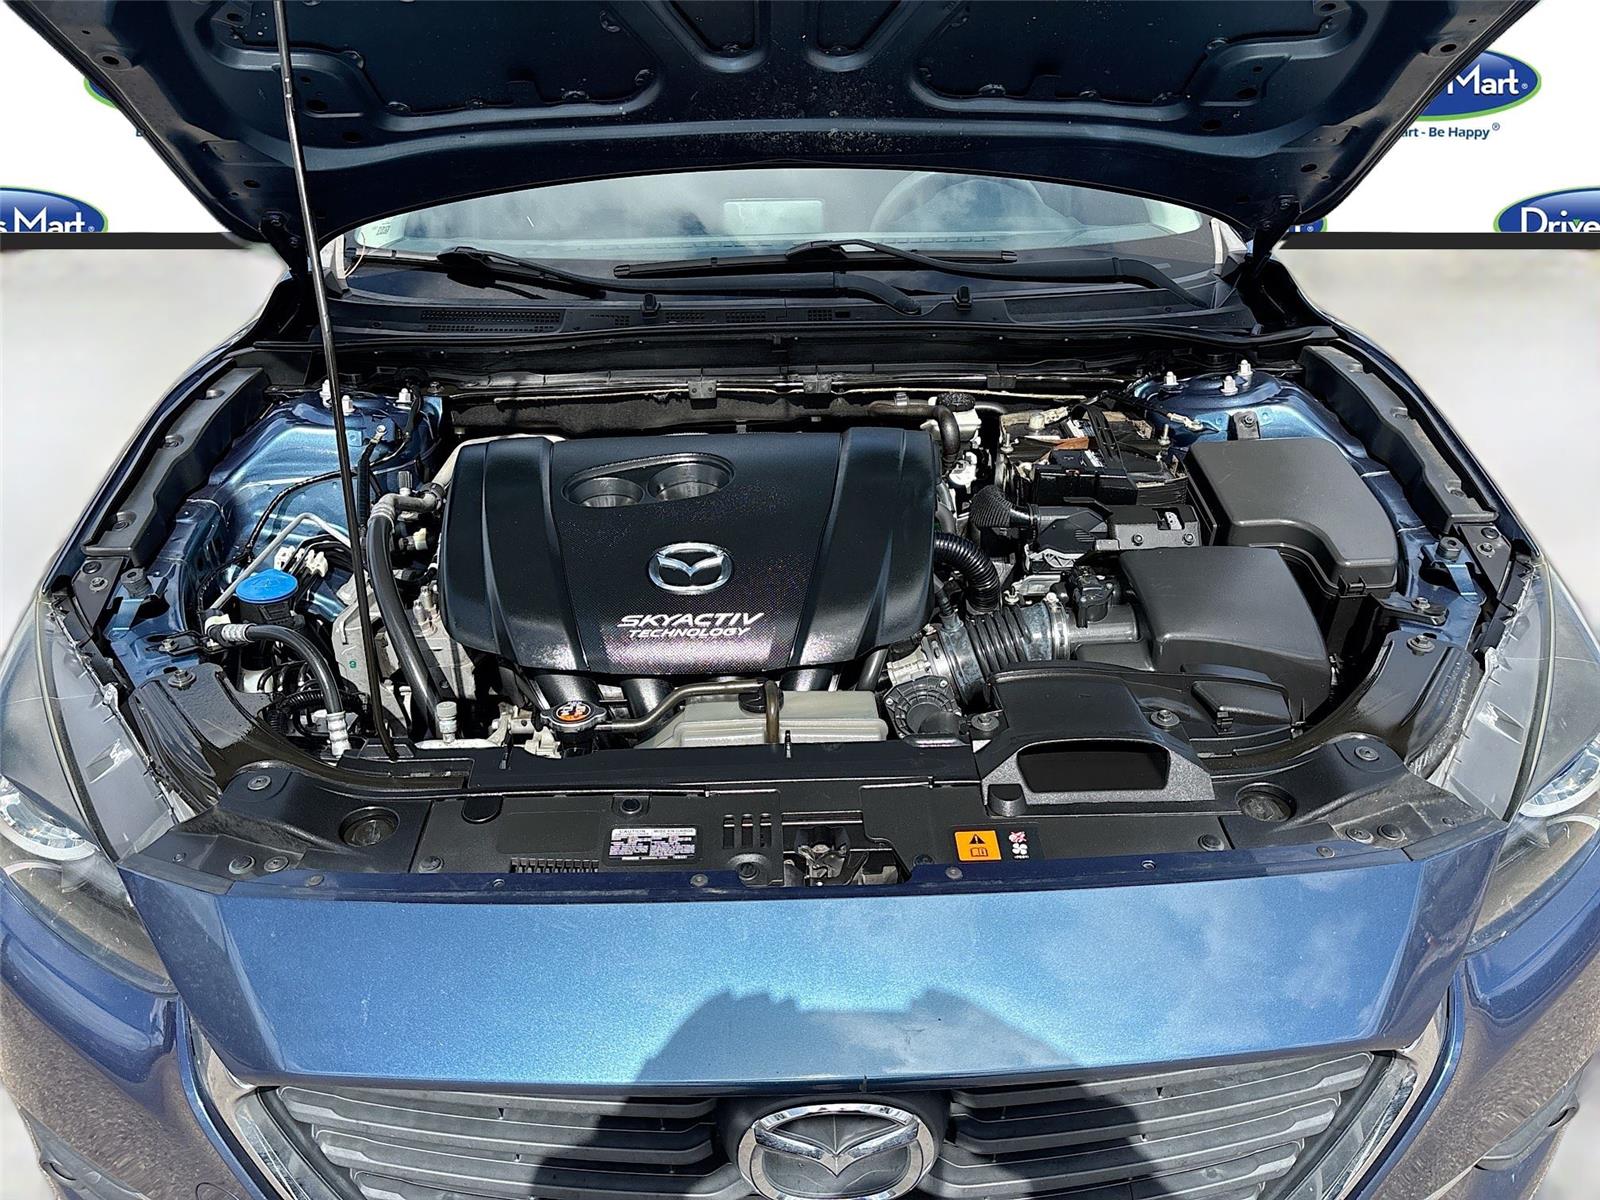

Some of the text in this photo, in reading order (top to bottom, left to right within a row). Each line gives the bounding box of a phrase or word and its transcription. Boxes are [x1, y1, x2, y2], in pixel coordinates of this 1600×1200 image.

[1447, 64, 1520, 94] Mart
[1429, 127, 1445, 137] Be
[1448, 127, 1490, 140] Happy
[14, 207, 85, 232] Mart
[616, 612, 765, 628] SKYACTIV
[628, 627, 751, 638] TECHNOLOGY
